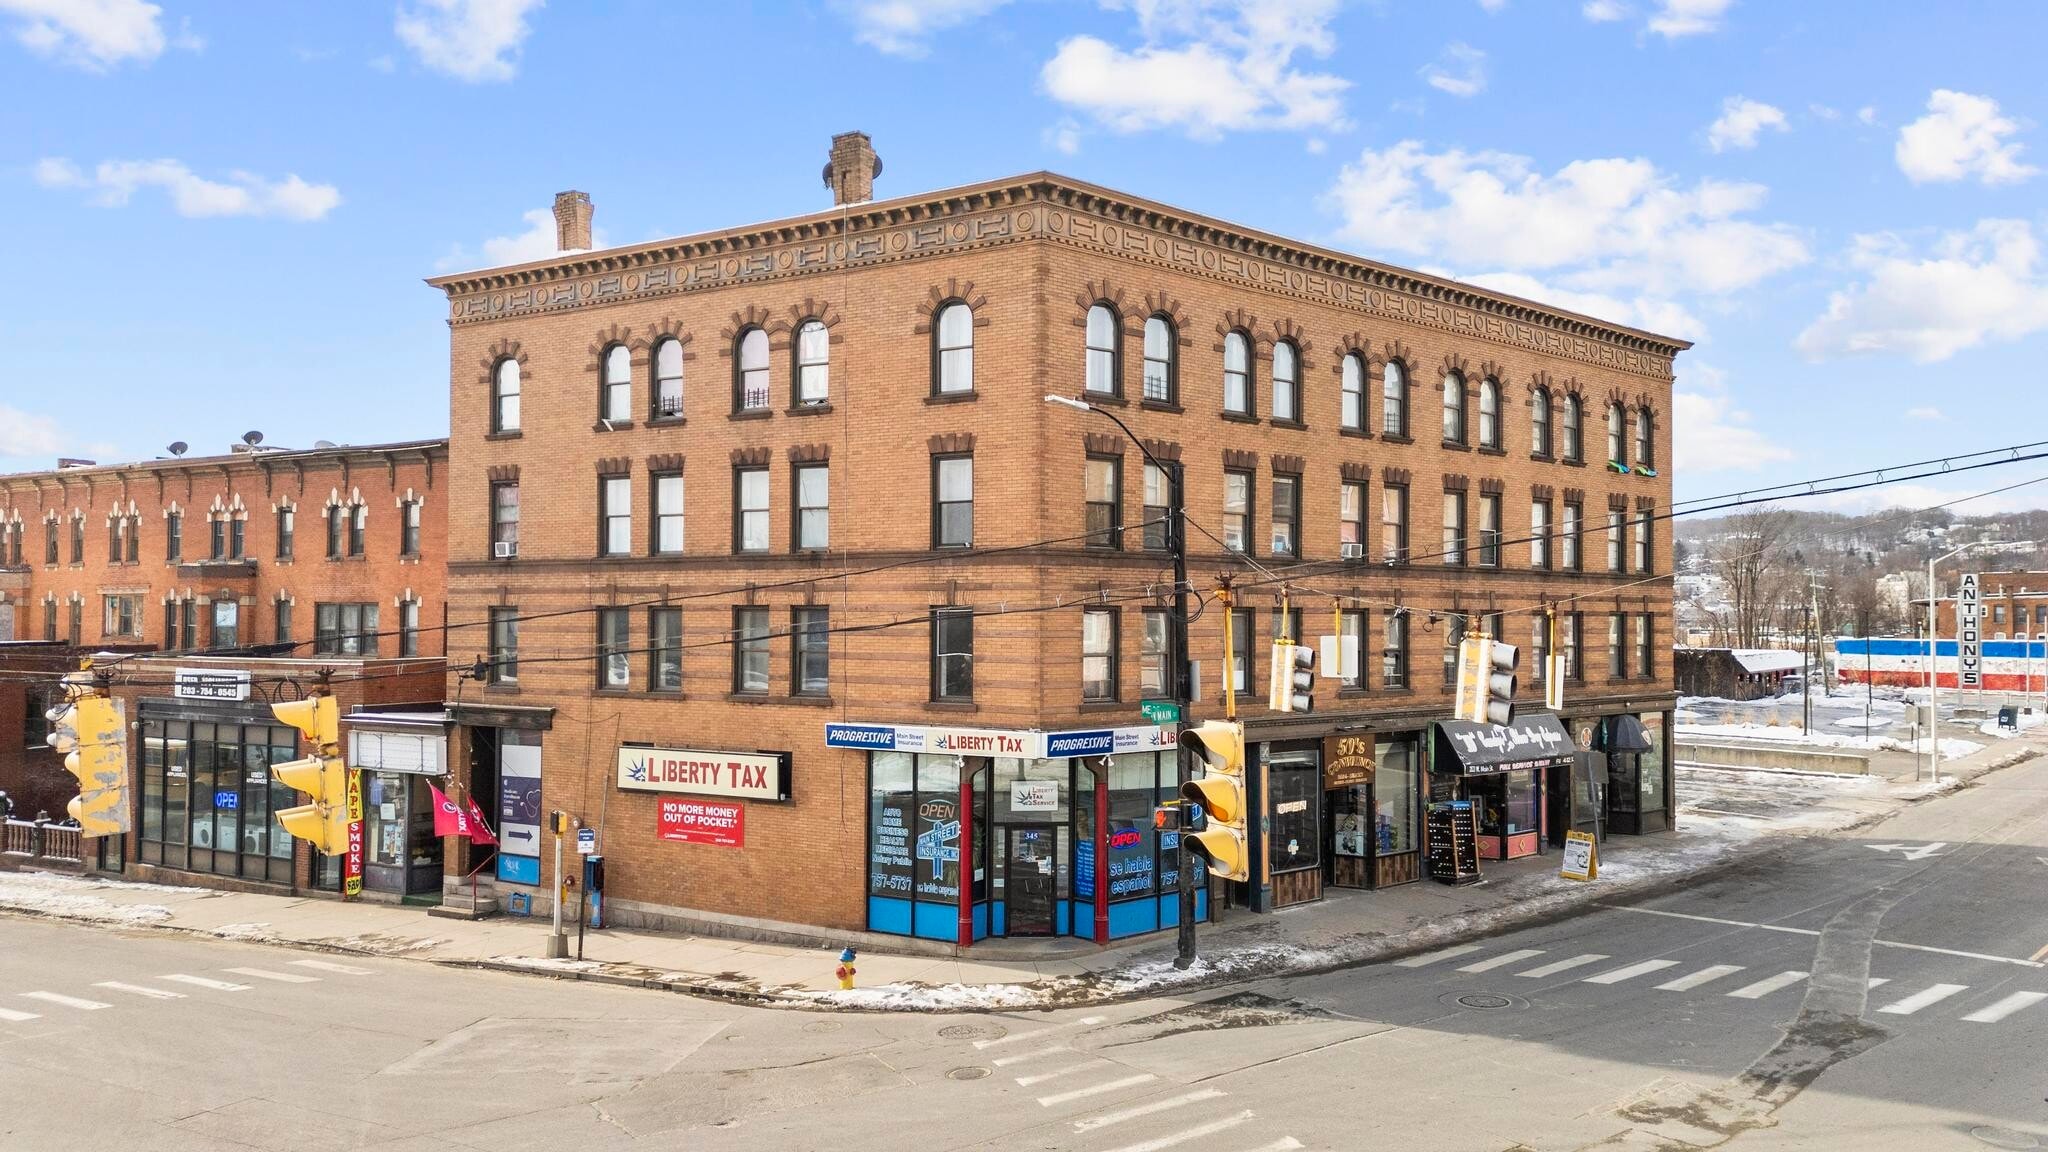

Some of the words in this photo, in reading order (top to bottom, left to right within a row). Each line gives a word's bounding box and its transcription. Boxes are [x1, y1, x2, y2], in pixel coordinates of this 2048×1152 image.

[1963, 575, 1977, 684] ANTHONYS
[1157, 710, 1172, 720] MAIN
[829, 729, 893, 744] PROGRESSIVE
[1050, 736, 1112, 751] PROGRESSIVE
[1337, 737, 1366, 755] 50's
[349, 769, 359, 819] VAPE
[663, 803, 677, 812] NO
[678, 804, 704, 815] MORE
[705, 807, 738, 818] MONEY
[883, 808, 902, 817] AUTO
[920, 803, 955, 818] OPEN
[1277, 800, 1306, 814] OPEN
[664, 813, 682, 823] OUT
[683, 815, 696, 825] OF
[882, 817, 902, 827] HOME
[877, 826, 909, 837] BUSINESS
[931, 825, 956, 841] STREET
[1025, 832, 1038, 840] 345
[1111, 831, 1141, 847] OPEN
[350, 822, 361, 873] SMOKE
[879, 836, 905, 846] HEALTH
[876, 845, 909, 856] MEDICARE
[872, 854, 892, 865] Notary
[892, 856, 912, 866] Public
[1110, 862, 1123, 876] se
[1125, 855, 1152, 874] habla
[872, 873, 912, 891] 757-5737
[1111, 873, 1152, 895] español
